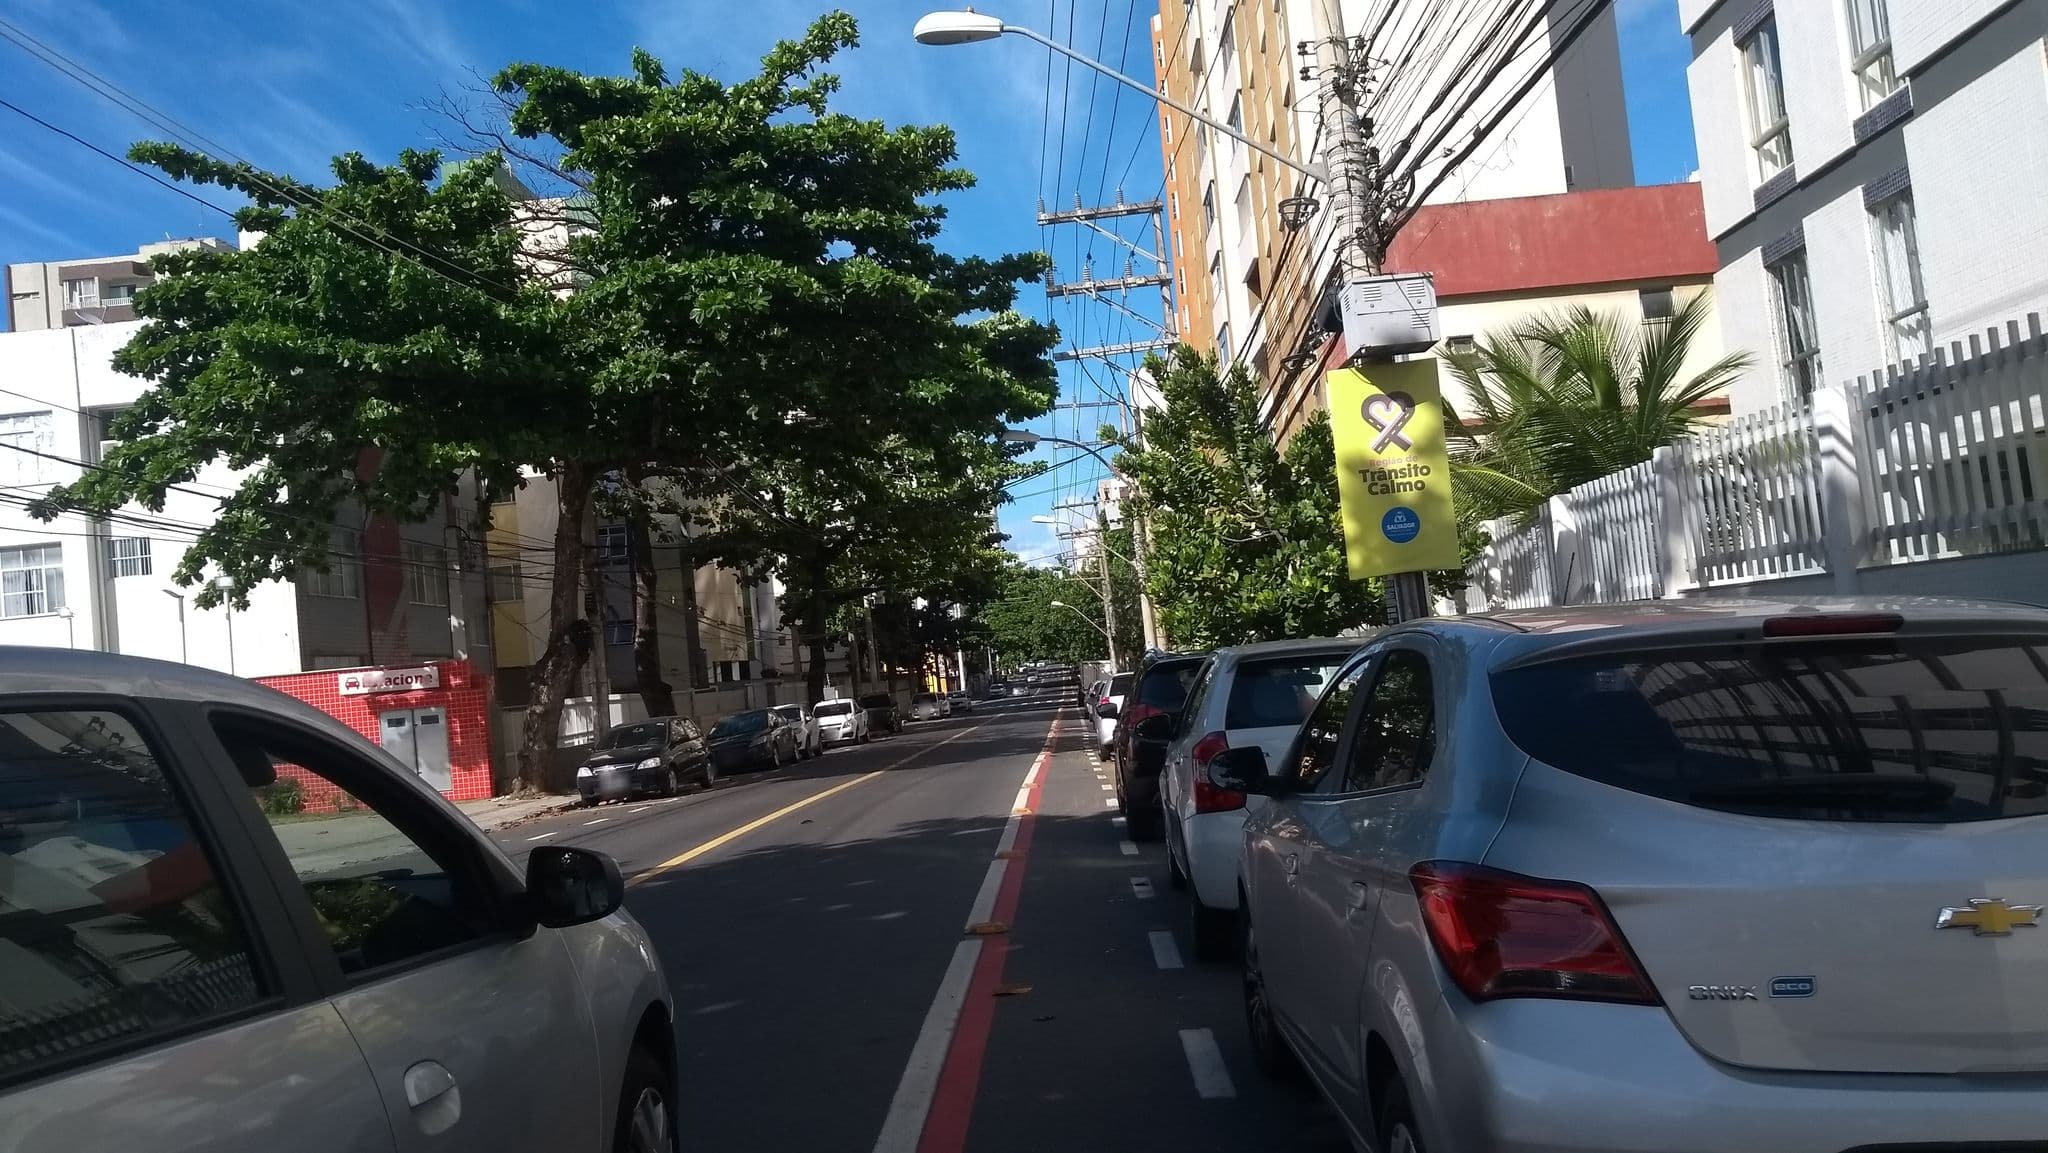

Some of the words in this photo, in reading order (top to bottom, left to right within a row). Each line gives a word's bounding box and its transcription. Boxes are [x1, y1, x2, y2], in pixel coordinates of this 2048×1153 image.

[1359, 463, 1431, 482] Trânsito
[1367, 479, 1426, 496] Calmo
[362, 672, 434, 688] acione
[1689, 985, 1759, 1001] ONIX
[1773, 982, 1811, 991] eco
